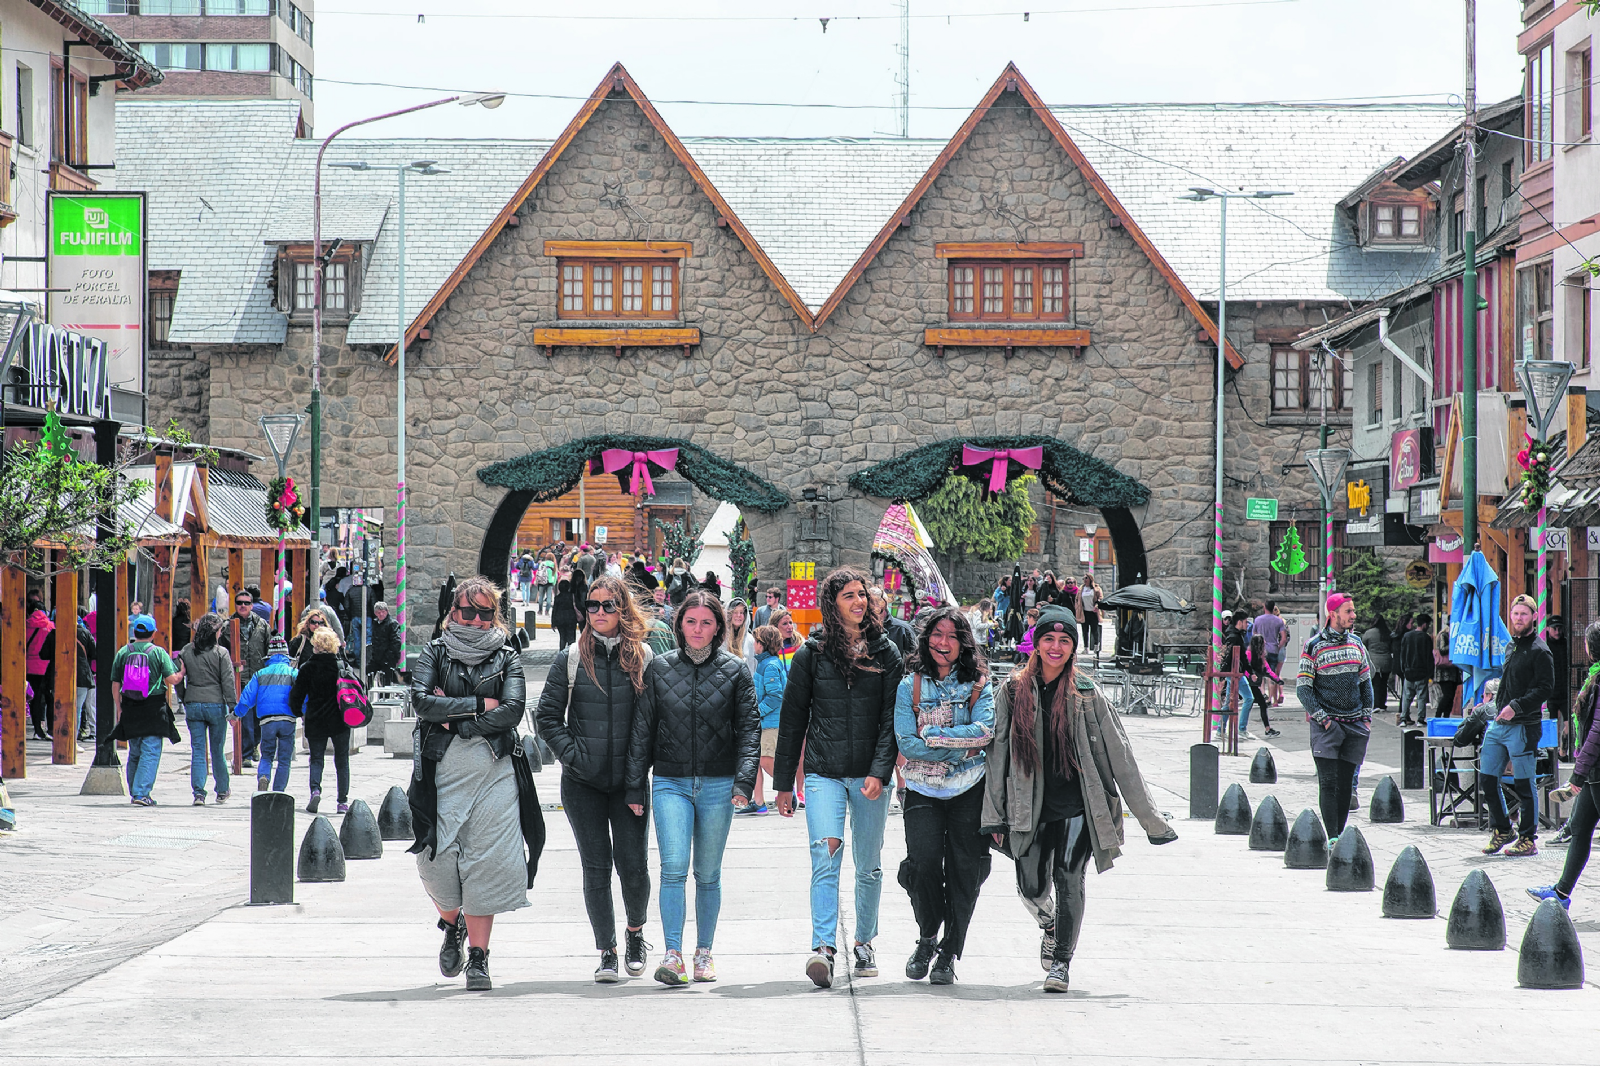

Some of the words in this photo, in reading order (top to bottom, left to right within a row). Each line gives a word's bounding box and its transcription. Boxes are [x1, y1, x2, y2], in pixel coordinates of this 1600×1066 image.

[60, 231, 132, 246] FUJIFILM
[81, 268, 114, 279] FOTO
[74, 282, 120, 292] PORCEL
[62, 295, 79, 305] DE
[81, 294, 132, 305] PERALTA
[28, 320, 113, 420] MOSTAZA
